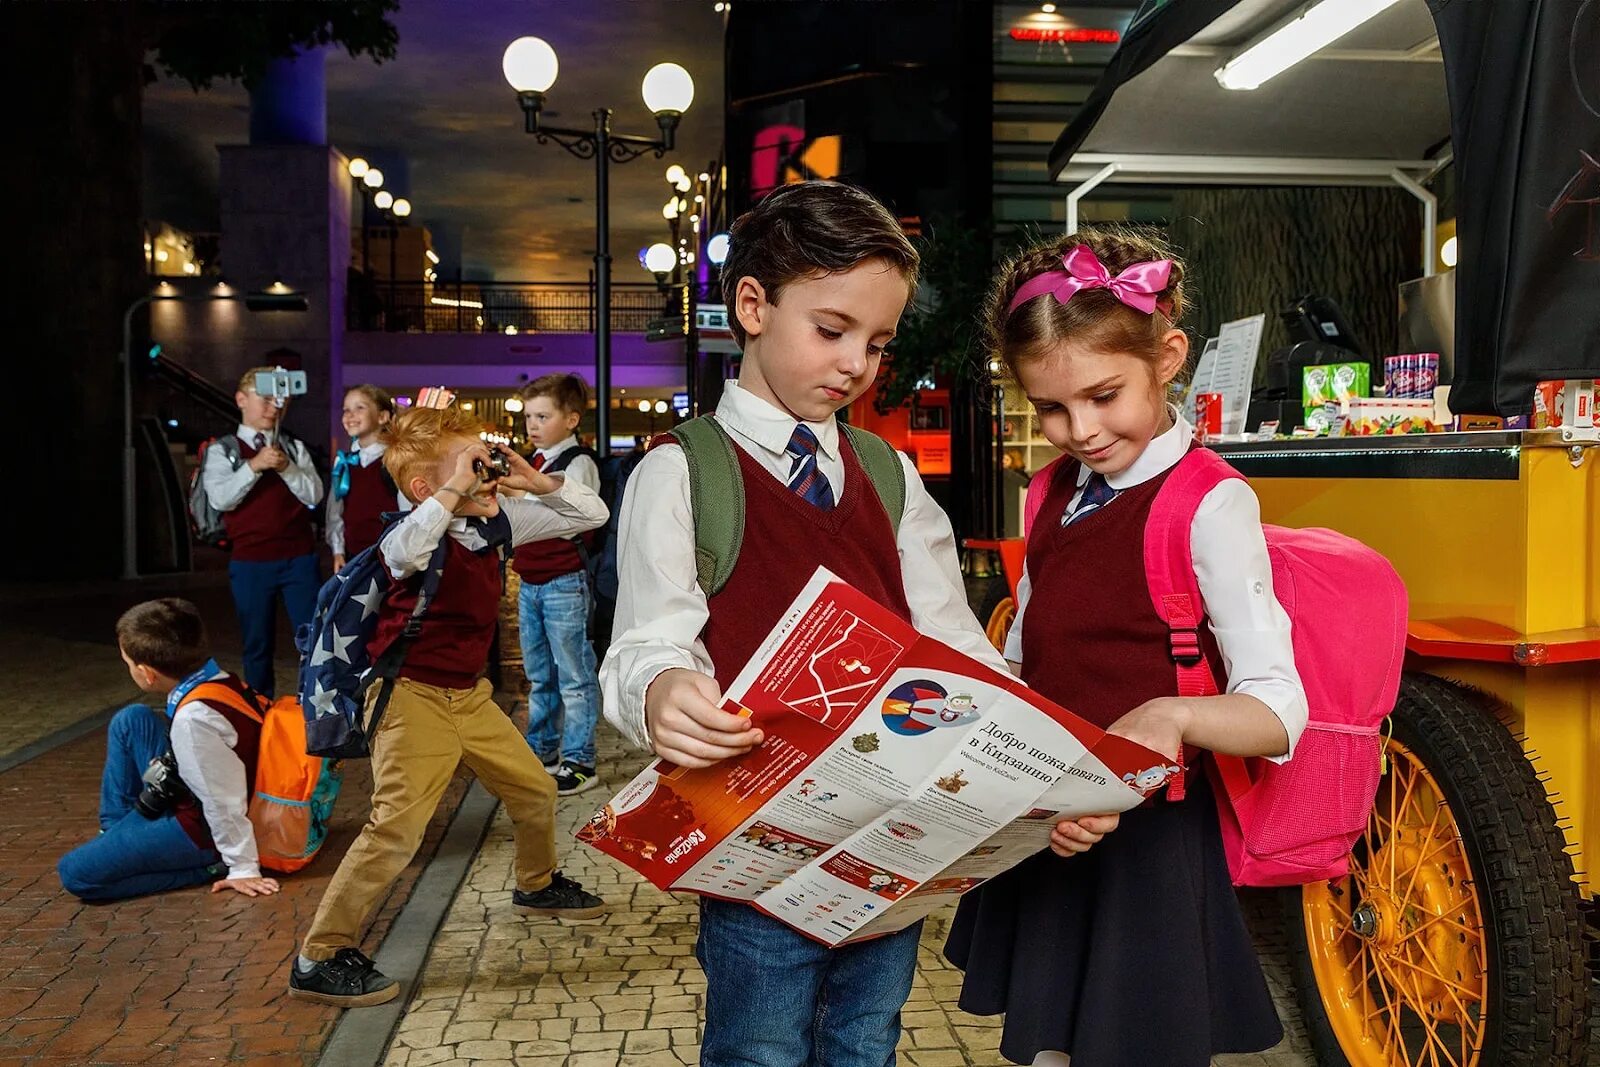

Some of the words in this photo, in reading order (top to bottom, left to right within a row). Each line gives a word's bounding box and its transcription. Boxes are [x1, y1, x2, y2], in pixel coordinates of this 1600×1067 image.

[960, 750, 986, 769] Welcome
[992, 765, 1020, 783] KidZania!
[968, 737, 979, 747] в
[981, 741, 1062, 788] Кидзанию!
[979, 720, 1026, 751] Добро
[1027, 747, 1107, 786] пожаловать
[664, 828, 707, 865] KidZania
[669, 835, 684, 848] Moscow
